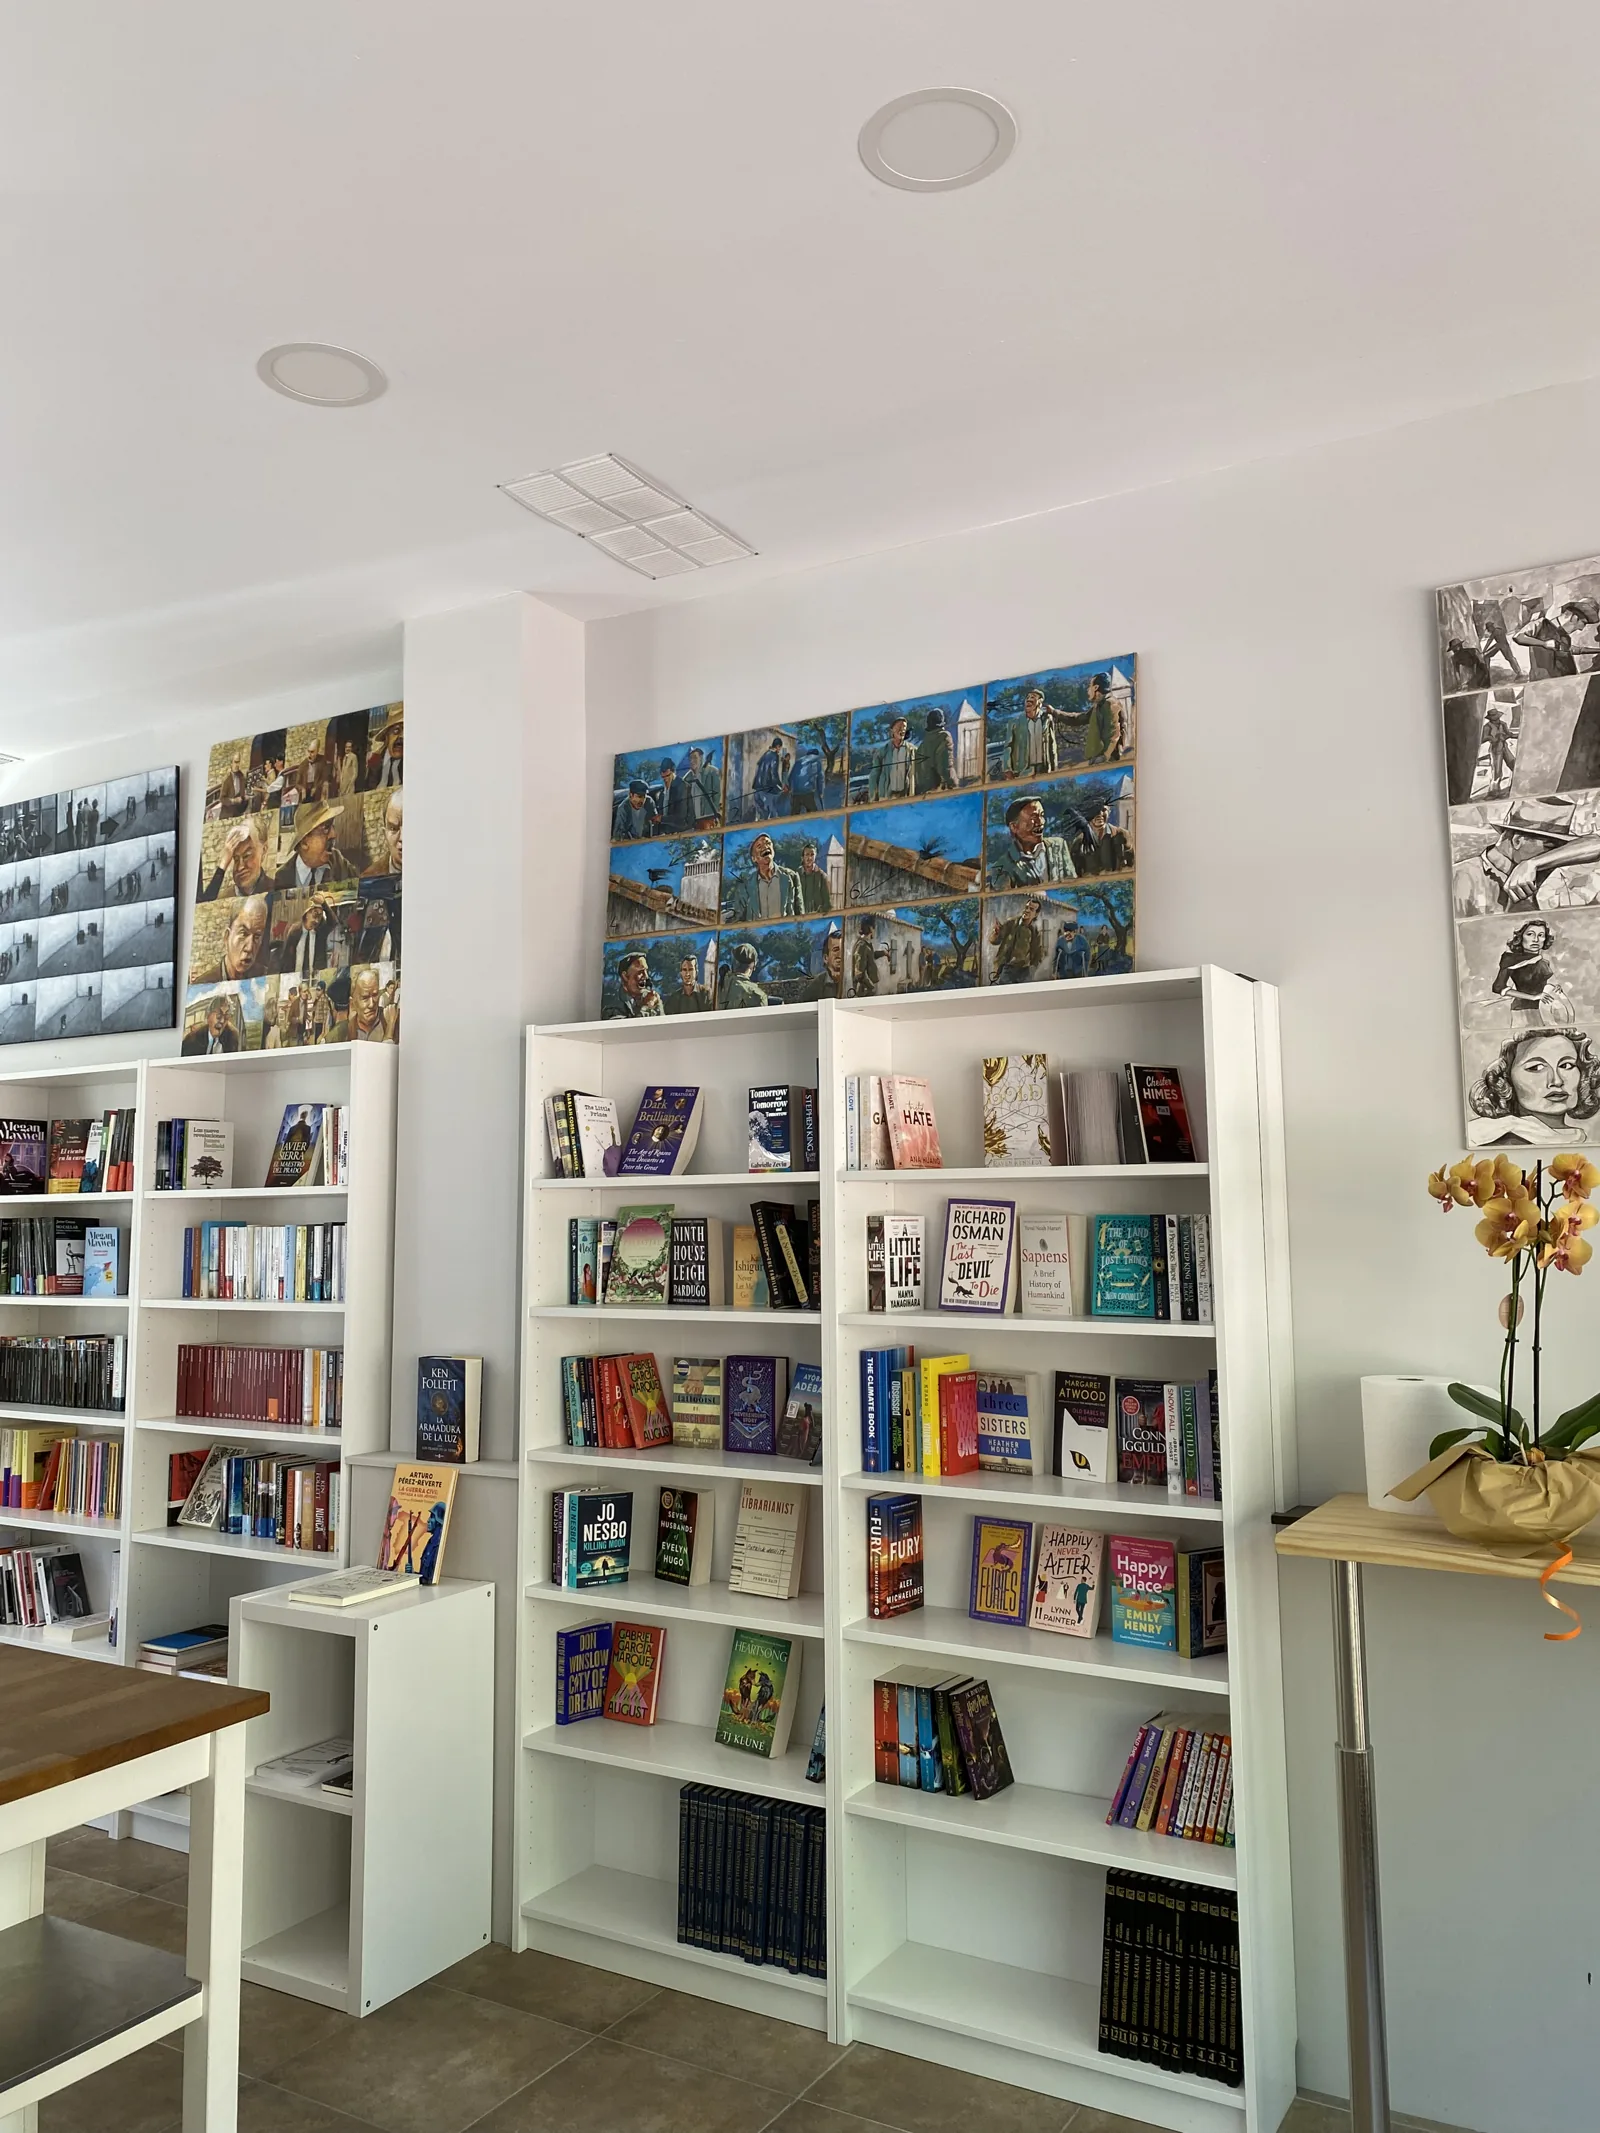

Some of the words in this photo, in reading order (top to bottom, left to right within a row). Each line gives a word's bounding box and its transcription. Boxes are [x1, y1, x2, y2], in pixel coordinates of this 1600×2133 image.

[1146, 1076, 1172, 1087] Chester
[750, 1089, 788, 1098] Tomorrow
[1142, 1088, 1179, 1100] HIMES
[643, 1099, 668, 1109] Dark
[752, 1101, 788, 1109] Tomorrow
[638, 1111, 686, 1122] Brilliance
[805, 1094, 813, 1130] STEPHEN
[903, 1110, 933, 1127] HATE
[2, 1121, 40, 1133] Megan
[806, 1131, 814, 1152] KING
[278, 1150, 304, 1160] SIERRA
[623, 1156, 636, 1164] from
[89, 1231, 113, 1240] Megan
[673, 1226, 704, 1242] NINTH
[902, 1224, 908, 1236] A
[952, 1225, 1004, 1241] OSMAN
[1107, 1227, 1123, 1238] THE
[1128, 1227, 1149, 1238] LAND
[88, 1239, 116, 1247] Maxwell
[889, 1237, 921, 1257] LITTLE
[955, 1241, 967, 1250] The
[1119, 1239, 1129, 1249] OF
[673, 1245, 706, 1261] HOUSE
[868, 1251, 885, 1261] LIFE
[949, 1244, 978, 1262] Last
[1022, 1248, 1068, 1267] Sapiens
[735, 1260, 763, 1274] Ishigur
[1101, 1255, 1120, 1269] LOST
[1123, 1255, 1149, 1267] THINGS
[889, 1257, 921, 1287] LIFE
[1040, 1270, 1055, 1278] Brief
[673, 1284, 706, 1297] BARDUGO
[970, 1281, 979, 1290] To
[978, 1280, 1000, 1298] Die
[1029, 1280, 1052, 1291] History
[1053, 1280, 1062, 1288] of
[897, 1290, 914, 1299] HANYA
[1027, 1291, 1065, 1300] Humankind
[890, 1299, 921, 1309] YANAGIHARA
[432, 1367, 448, 1378] KEN
[422, 1377, 458, 1391] FOLLETT
[1064, 1379, 1101, 1389] MARGARET
[867, 1375, 875, 1412] CLIMATE
[891, 1380, 902, 1416] Obsessed
[1058, 1388, 1107, 1401] ATWOOD
[984, 1396, 1021, 1412] three
[1183, 1390, 1192, 1420] DUST
[868, 1413, 876, 1438] BOOK
[980, 1416, 1027, 1436] SISTERS
[1087, 1416, 1105, 1424] WOOD
[419, 1423, 461, 1434] ARMADURA
[643, 1425, 672, 1442] AUGUST
[423, 1433, 433, 1441] DE
[434, 1433, 443, 1442] LA
[444, 1435, 457, 1443] LUZ
[988, 1439, 1020, 1448] HEATHER
[1185, 1422, 1194, 1457] CHILD
[990, 1446, 1018, 1455] MORRIS
[1121, 1437, 1166, 1454] IGGULD
[743, 1487, 753, 1496] THE
[570, 1500, 578, 1512] JO
[596, 1502, 615, 1522] JO
[741, 1497, 795, 1515] LIBRARIANIST
[667, 1511, 688, 1521] SEVEN
[583, 1520, 627, 1542] NESBO
[660, 1521, 693, 1534] HUSBANDS
[871, 1517, 882, 1556] FURY
[1049, 1531, 1093, 1551] HAPPILY
[583, 1540, 607, 1551] KILLING
[608, 1538, 626, 1550] MOON
[661, 1541, 689, 1554] EVELYN
[890, 1536, 921, 1561] FURY
[1056, 1547, 1080, 1556] NEVER
[663, 1554, 684, 1567] HUGO
[1044, 1553, 1094, 1576] AFTER
[1117, 1554, 1168, 1580] Happy
[899, 1579, 913, 1589] ALEX
[1122, 1573, 1163, 1593] Place
[886, 1586, 923, 1603] MICHAELIDES
[1050, 1605, 1071, 1616] LYNN
[1126, 1609, 1161, 1624] EMILY
[1043, 1614, 1077, 1627] PAINTER
[1124, 1620, 1162, 1635] HENRY
[580, 1631, 597, 1652] DON
[619, 1629, 653, 1643] GABRIEL
[734, 1640, 788, 1663] HEARTSONG
[569, 1649, 609, 1674] WINSLOW
[569, 1671, 590, 1695] CITY
[592, 1668, 606, 1689] OF
[608, 1701, 648, 1720] AUGUST
[722, 1730, 732, 1744] TJ
[733, 1734, 765, 1751] KLUNE
